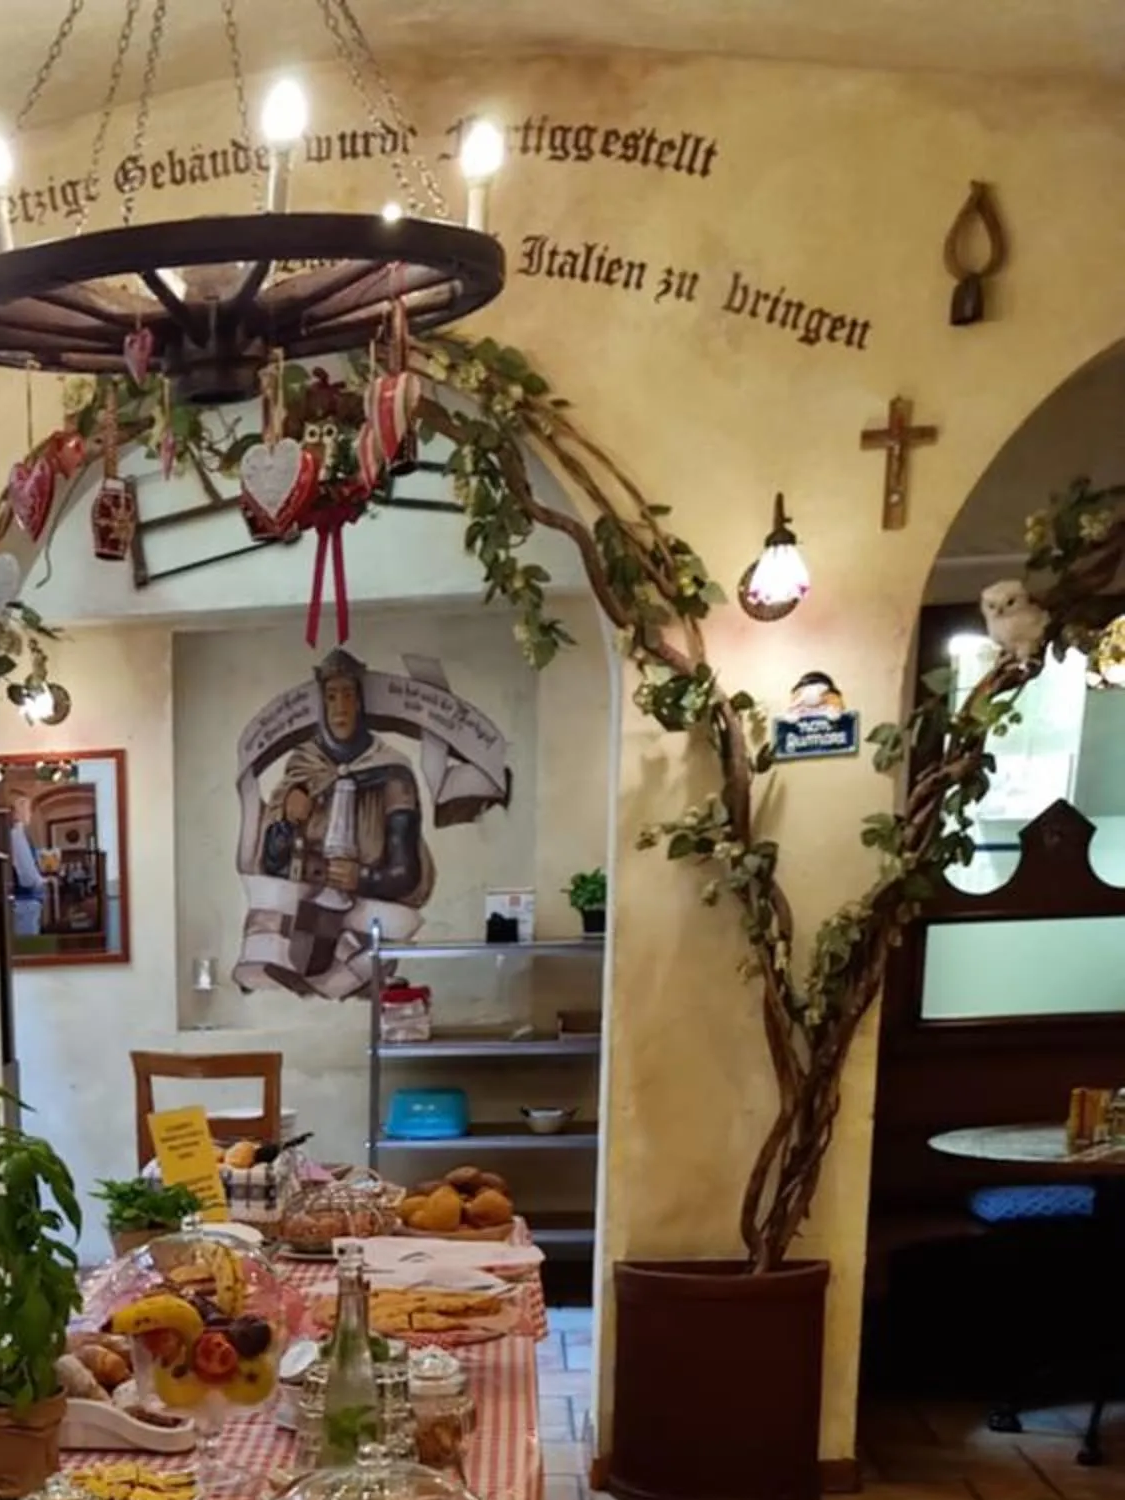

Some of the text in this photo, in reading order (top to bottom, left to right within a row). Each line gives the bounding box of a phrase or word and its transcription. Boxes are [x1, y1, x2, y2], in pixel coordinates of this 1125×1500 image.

[2, 112, 720, 227] etzige Gebäude wurde rtiggestellt
[516, 233, 874, 351] Italien zu bringen
